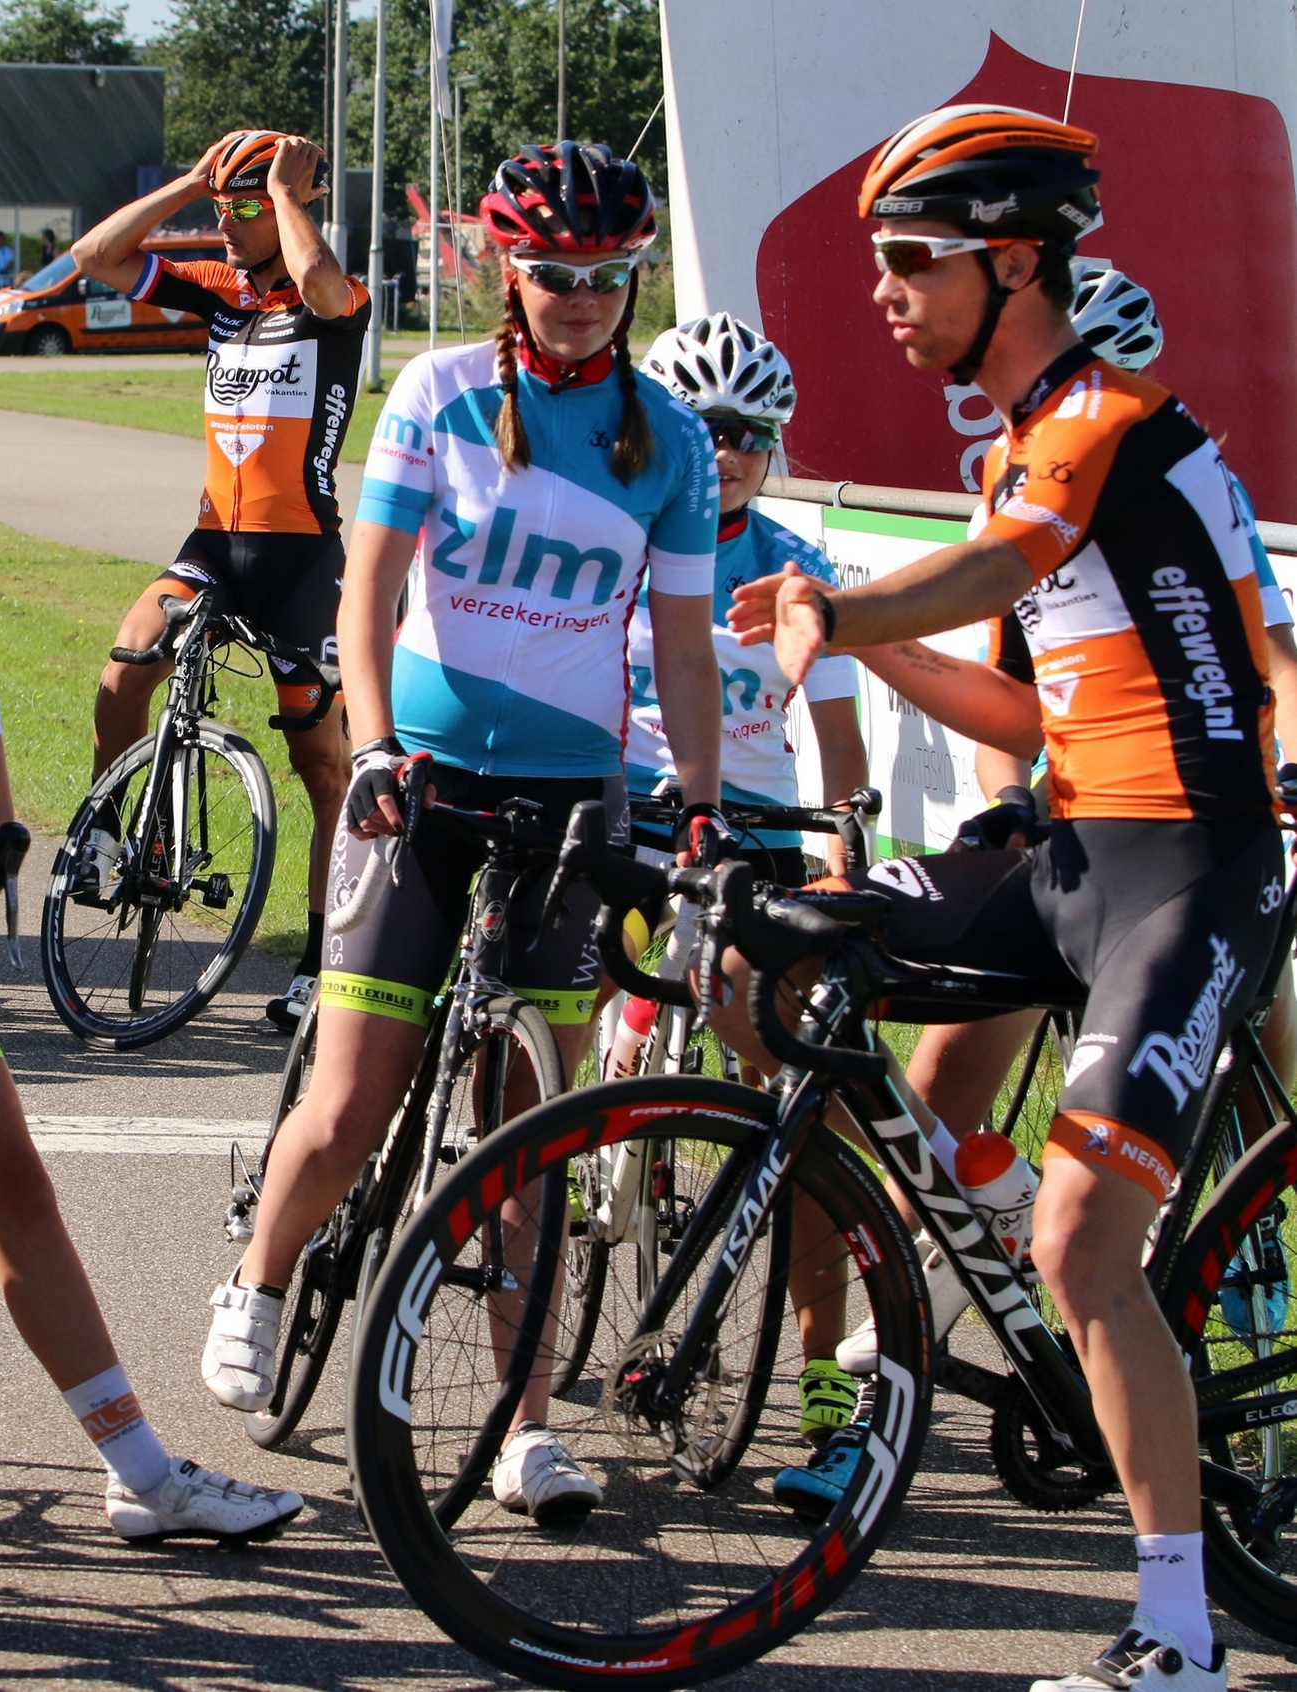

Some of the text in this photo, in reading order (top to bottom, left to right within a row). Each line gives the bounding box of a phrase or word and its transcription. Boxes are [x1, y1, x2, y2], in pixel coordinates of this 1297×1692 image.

[312, 383, 346, 497] effeweg.nl
[1148, 566, 1244, 741] effeweg.nl
[722, 1138, 791, 1276] ISAAC
